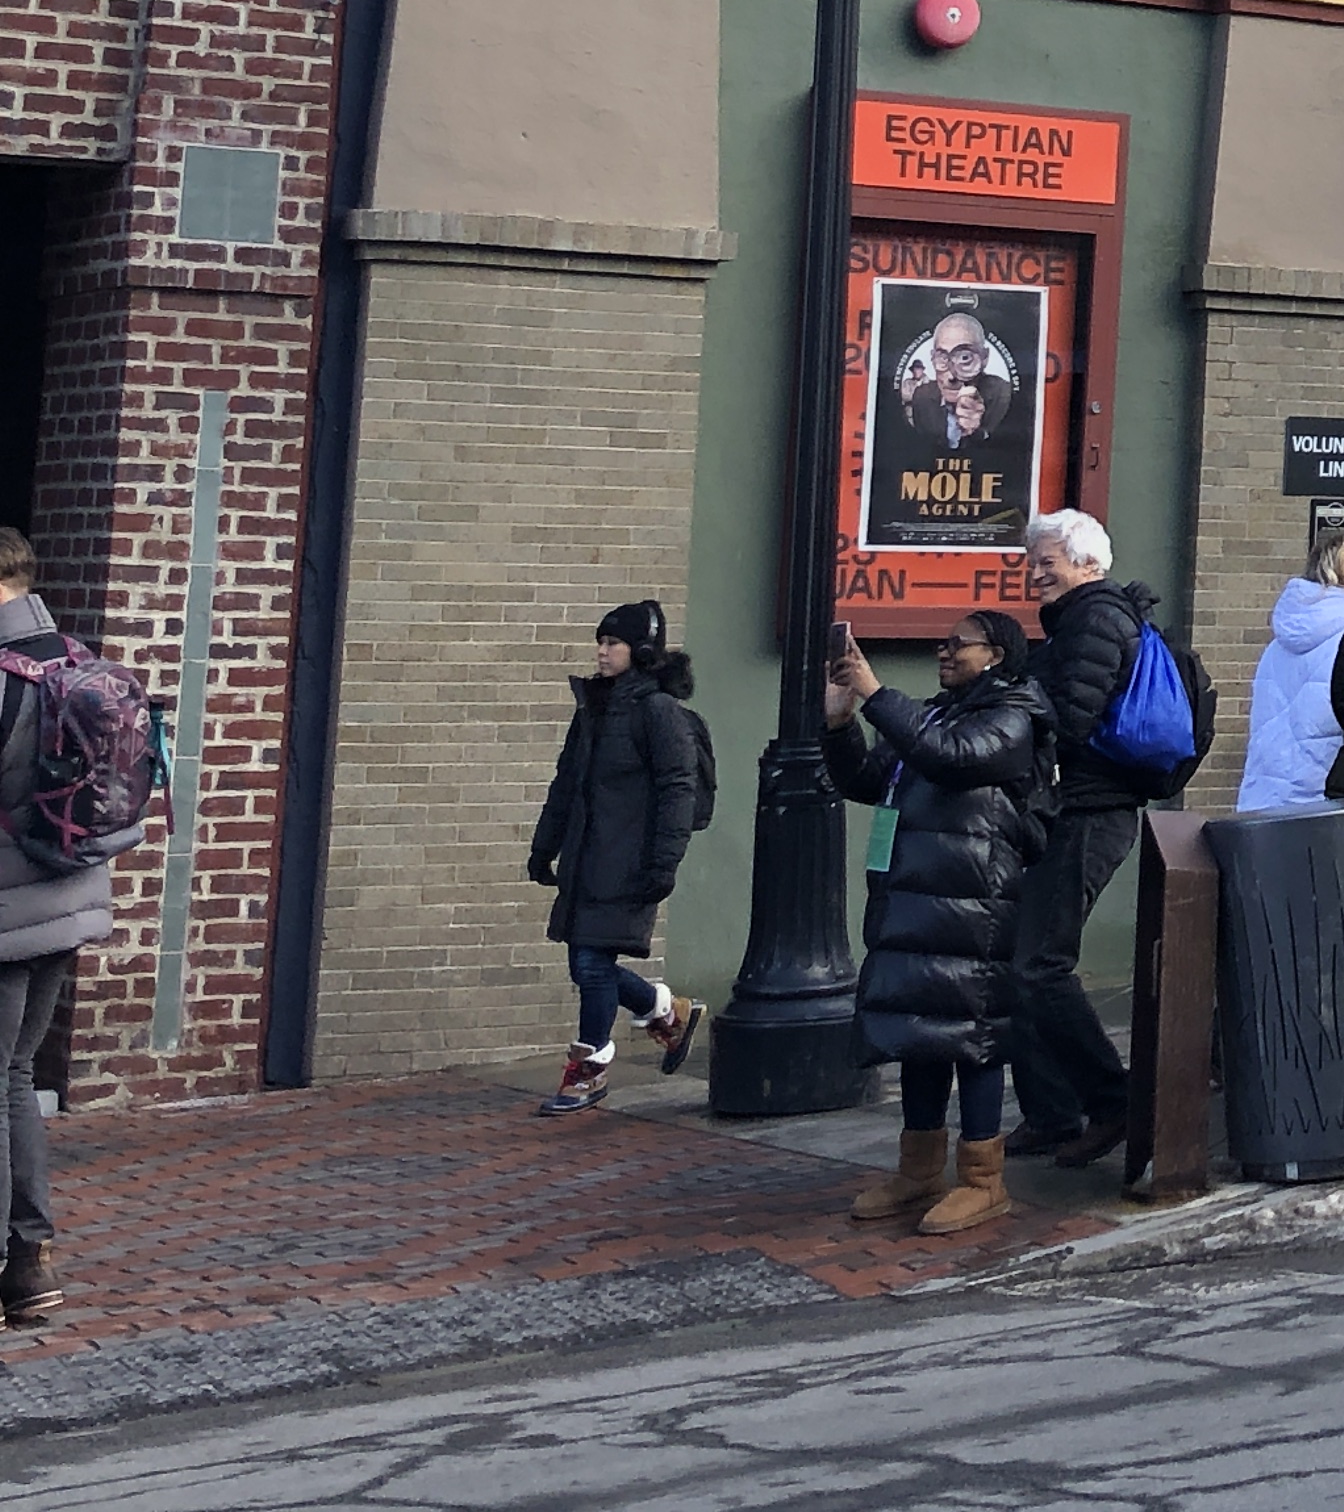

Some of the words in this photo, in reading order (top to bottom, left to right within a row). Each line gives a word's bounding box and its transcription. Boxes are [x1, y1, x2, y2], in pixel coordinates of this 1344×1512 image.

[885, 114, 1074, 157] EGYPTIAN
[892, 149, 1063, 189] THEATRE
[848, 240, 1066, 286] SUNDANCE
[934, 457, 972, 471] THE
[900, 471, 1004, 503] MOLE
[918, 503, 982, 516] AGENT
[836, 568, 906, 601] JAN
